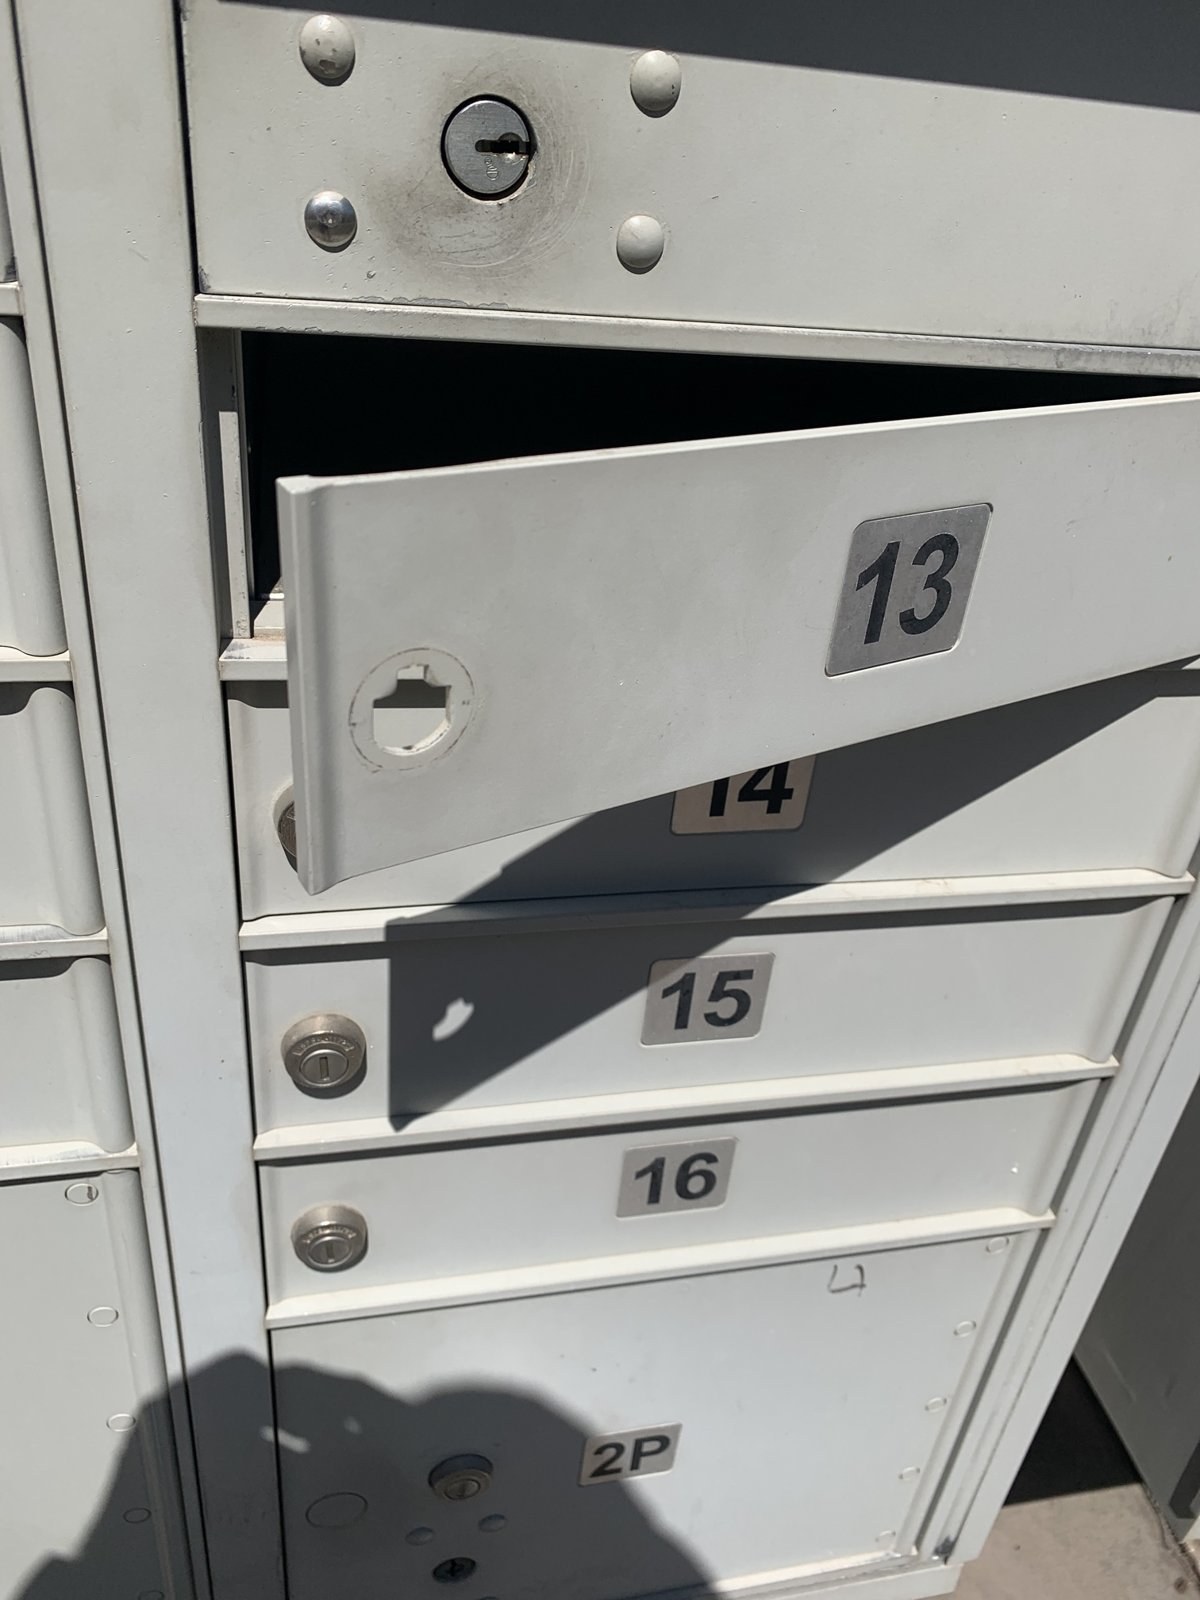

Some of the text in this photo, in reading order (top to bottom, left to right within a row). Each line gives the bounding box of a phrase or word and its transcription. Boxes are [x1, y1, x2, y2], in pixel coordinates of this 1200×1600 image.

[855, 533, 960, 645] 13
[661, 969, 754, 1030] 15
[634, 1151, 719, 1205] 16
[589, 1435, 671, 1478] 2P
